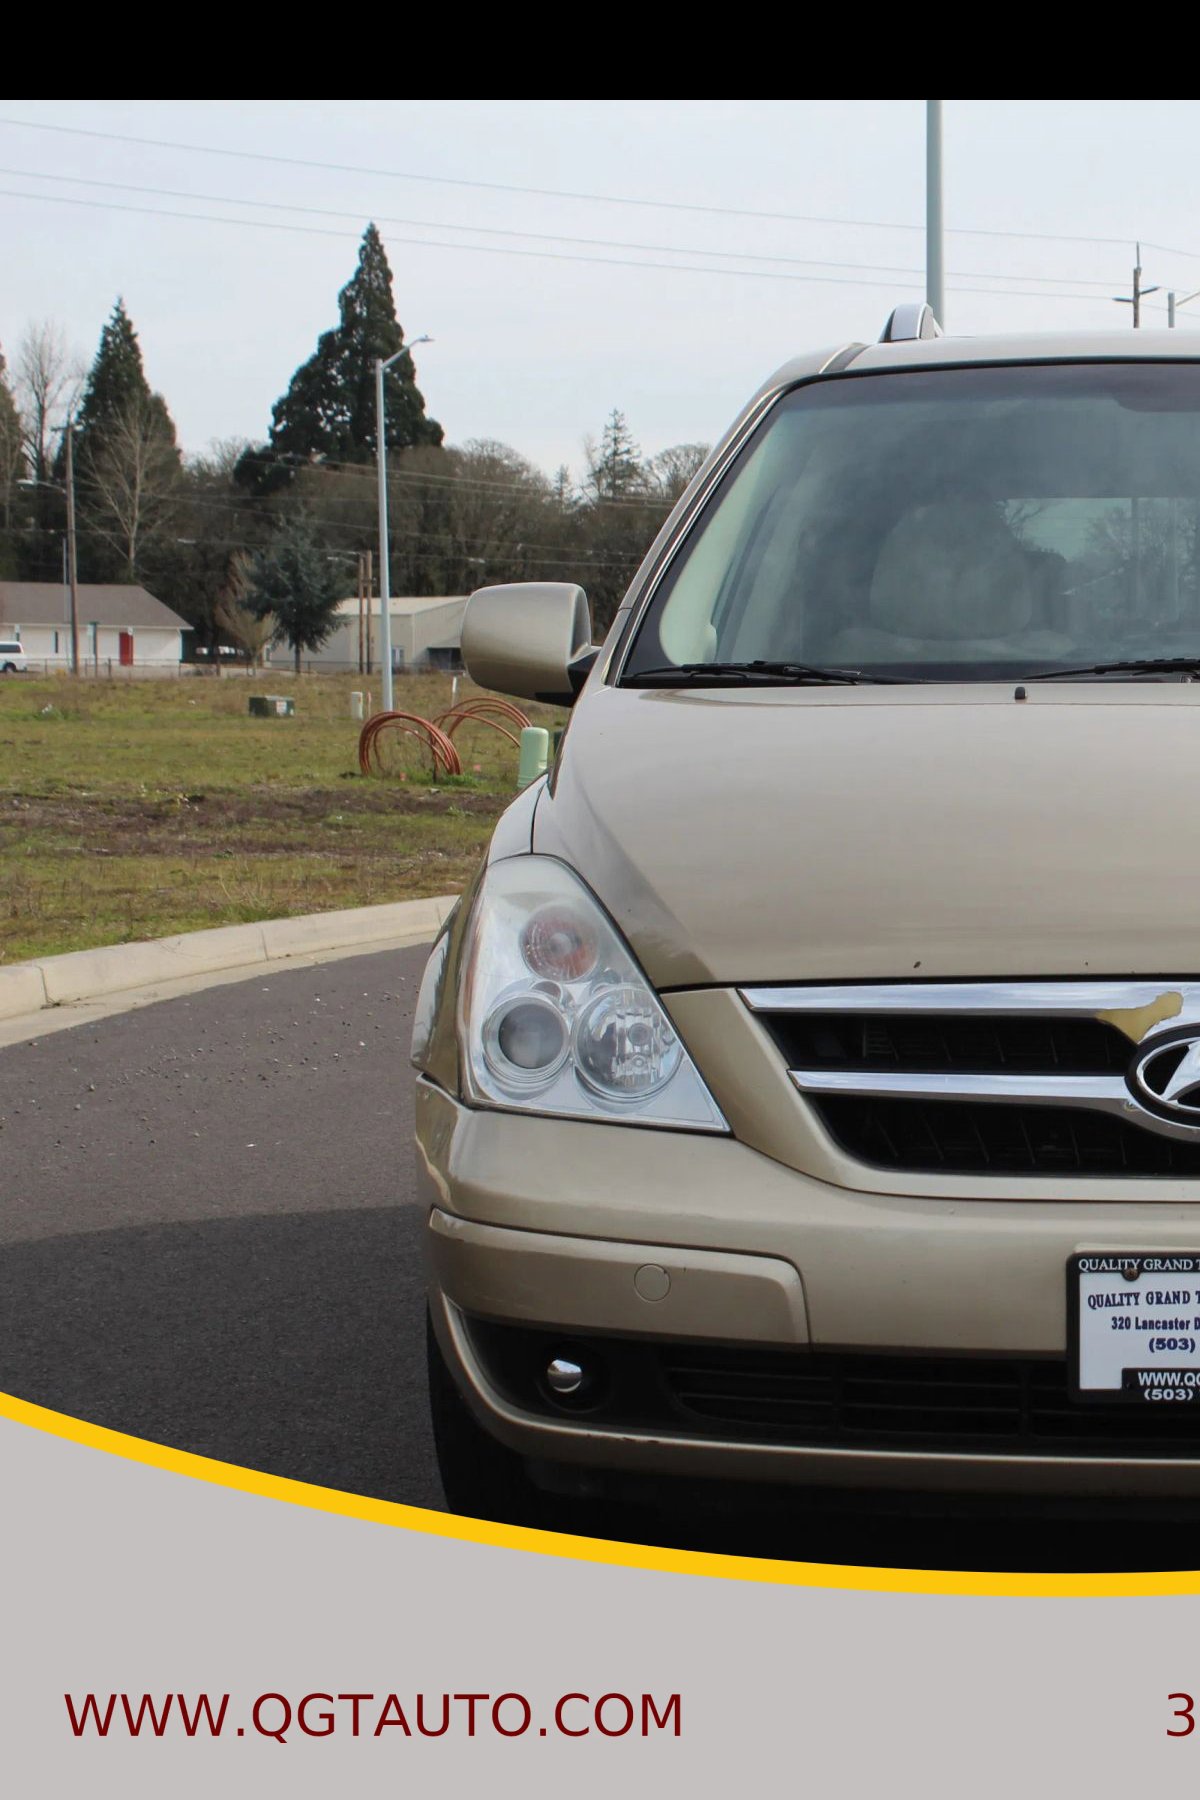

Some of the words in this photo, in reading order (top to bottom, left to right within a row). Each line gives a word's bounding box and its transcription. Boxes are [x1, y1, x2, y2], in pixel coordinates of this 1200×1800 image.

[1078, 1258, 1140, 1272] QUALITY
[1143, 1258, 1193, 1271] GRAND
[1087, 1292, 1140, 1310] QUALITY
[1145, 1291, 1191, 1305] GRAND
[1111, 1316, 1131, 1330] 320
[1135, 1316, 1191, 1331] Lancaster
[1148, 1338, 1196, 1352] (503)
[1143, 1388, 1194, 1401] (503)
